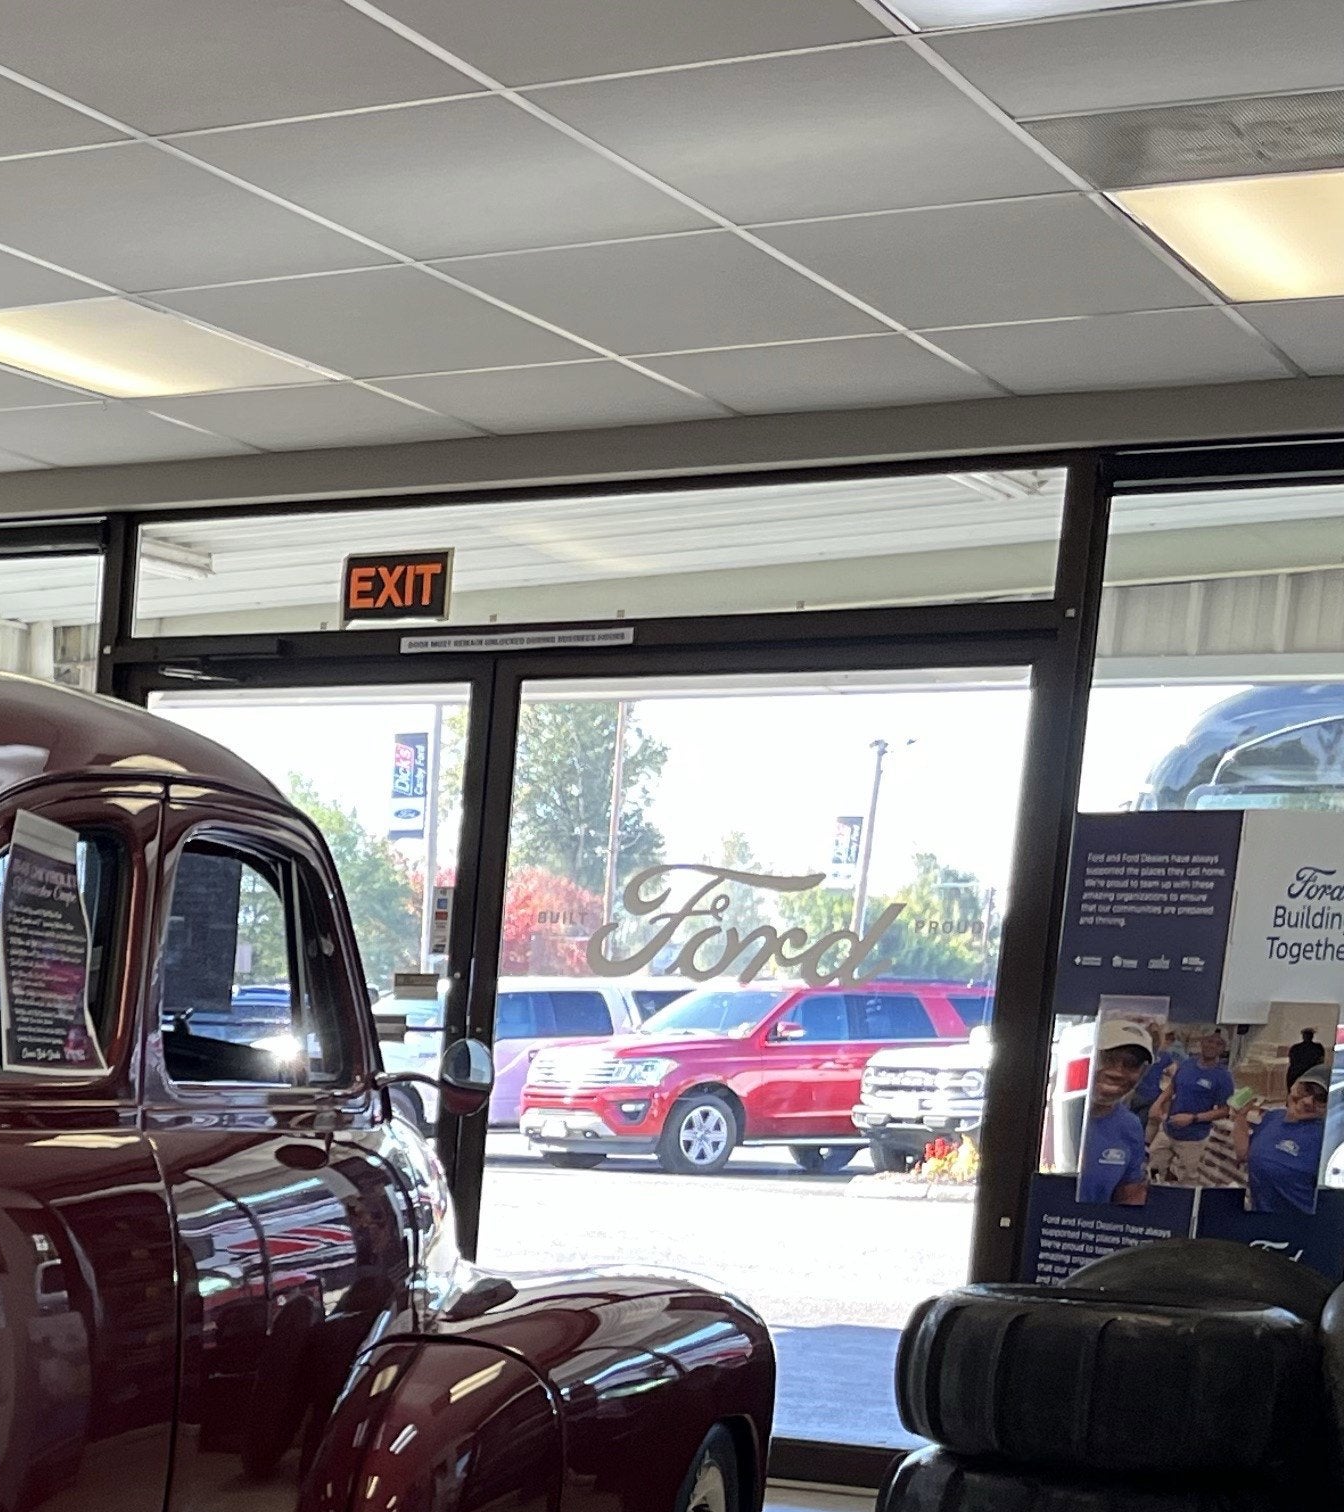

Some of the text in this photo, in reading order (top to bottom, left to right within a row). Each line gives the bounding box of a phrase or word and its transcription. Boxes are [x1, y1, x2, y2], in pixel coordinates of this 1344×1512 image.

[350, 563, 442, 609] EXIT
[537, 910, 589, 925] BUILT
[587, 864, 907, 987] Ford
[914, 919, 984, 934] PROUD
[1273, 905, 1343, 936] Buildin
[1266, 936, 1343, 965] Togethe
